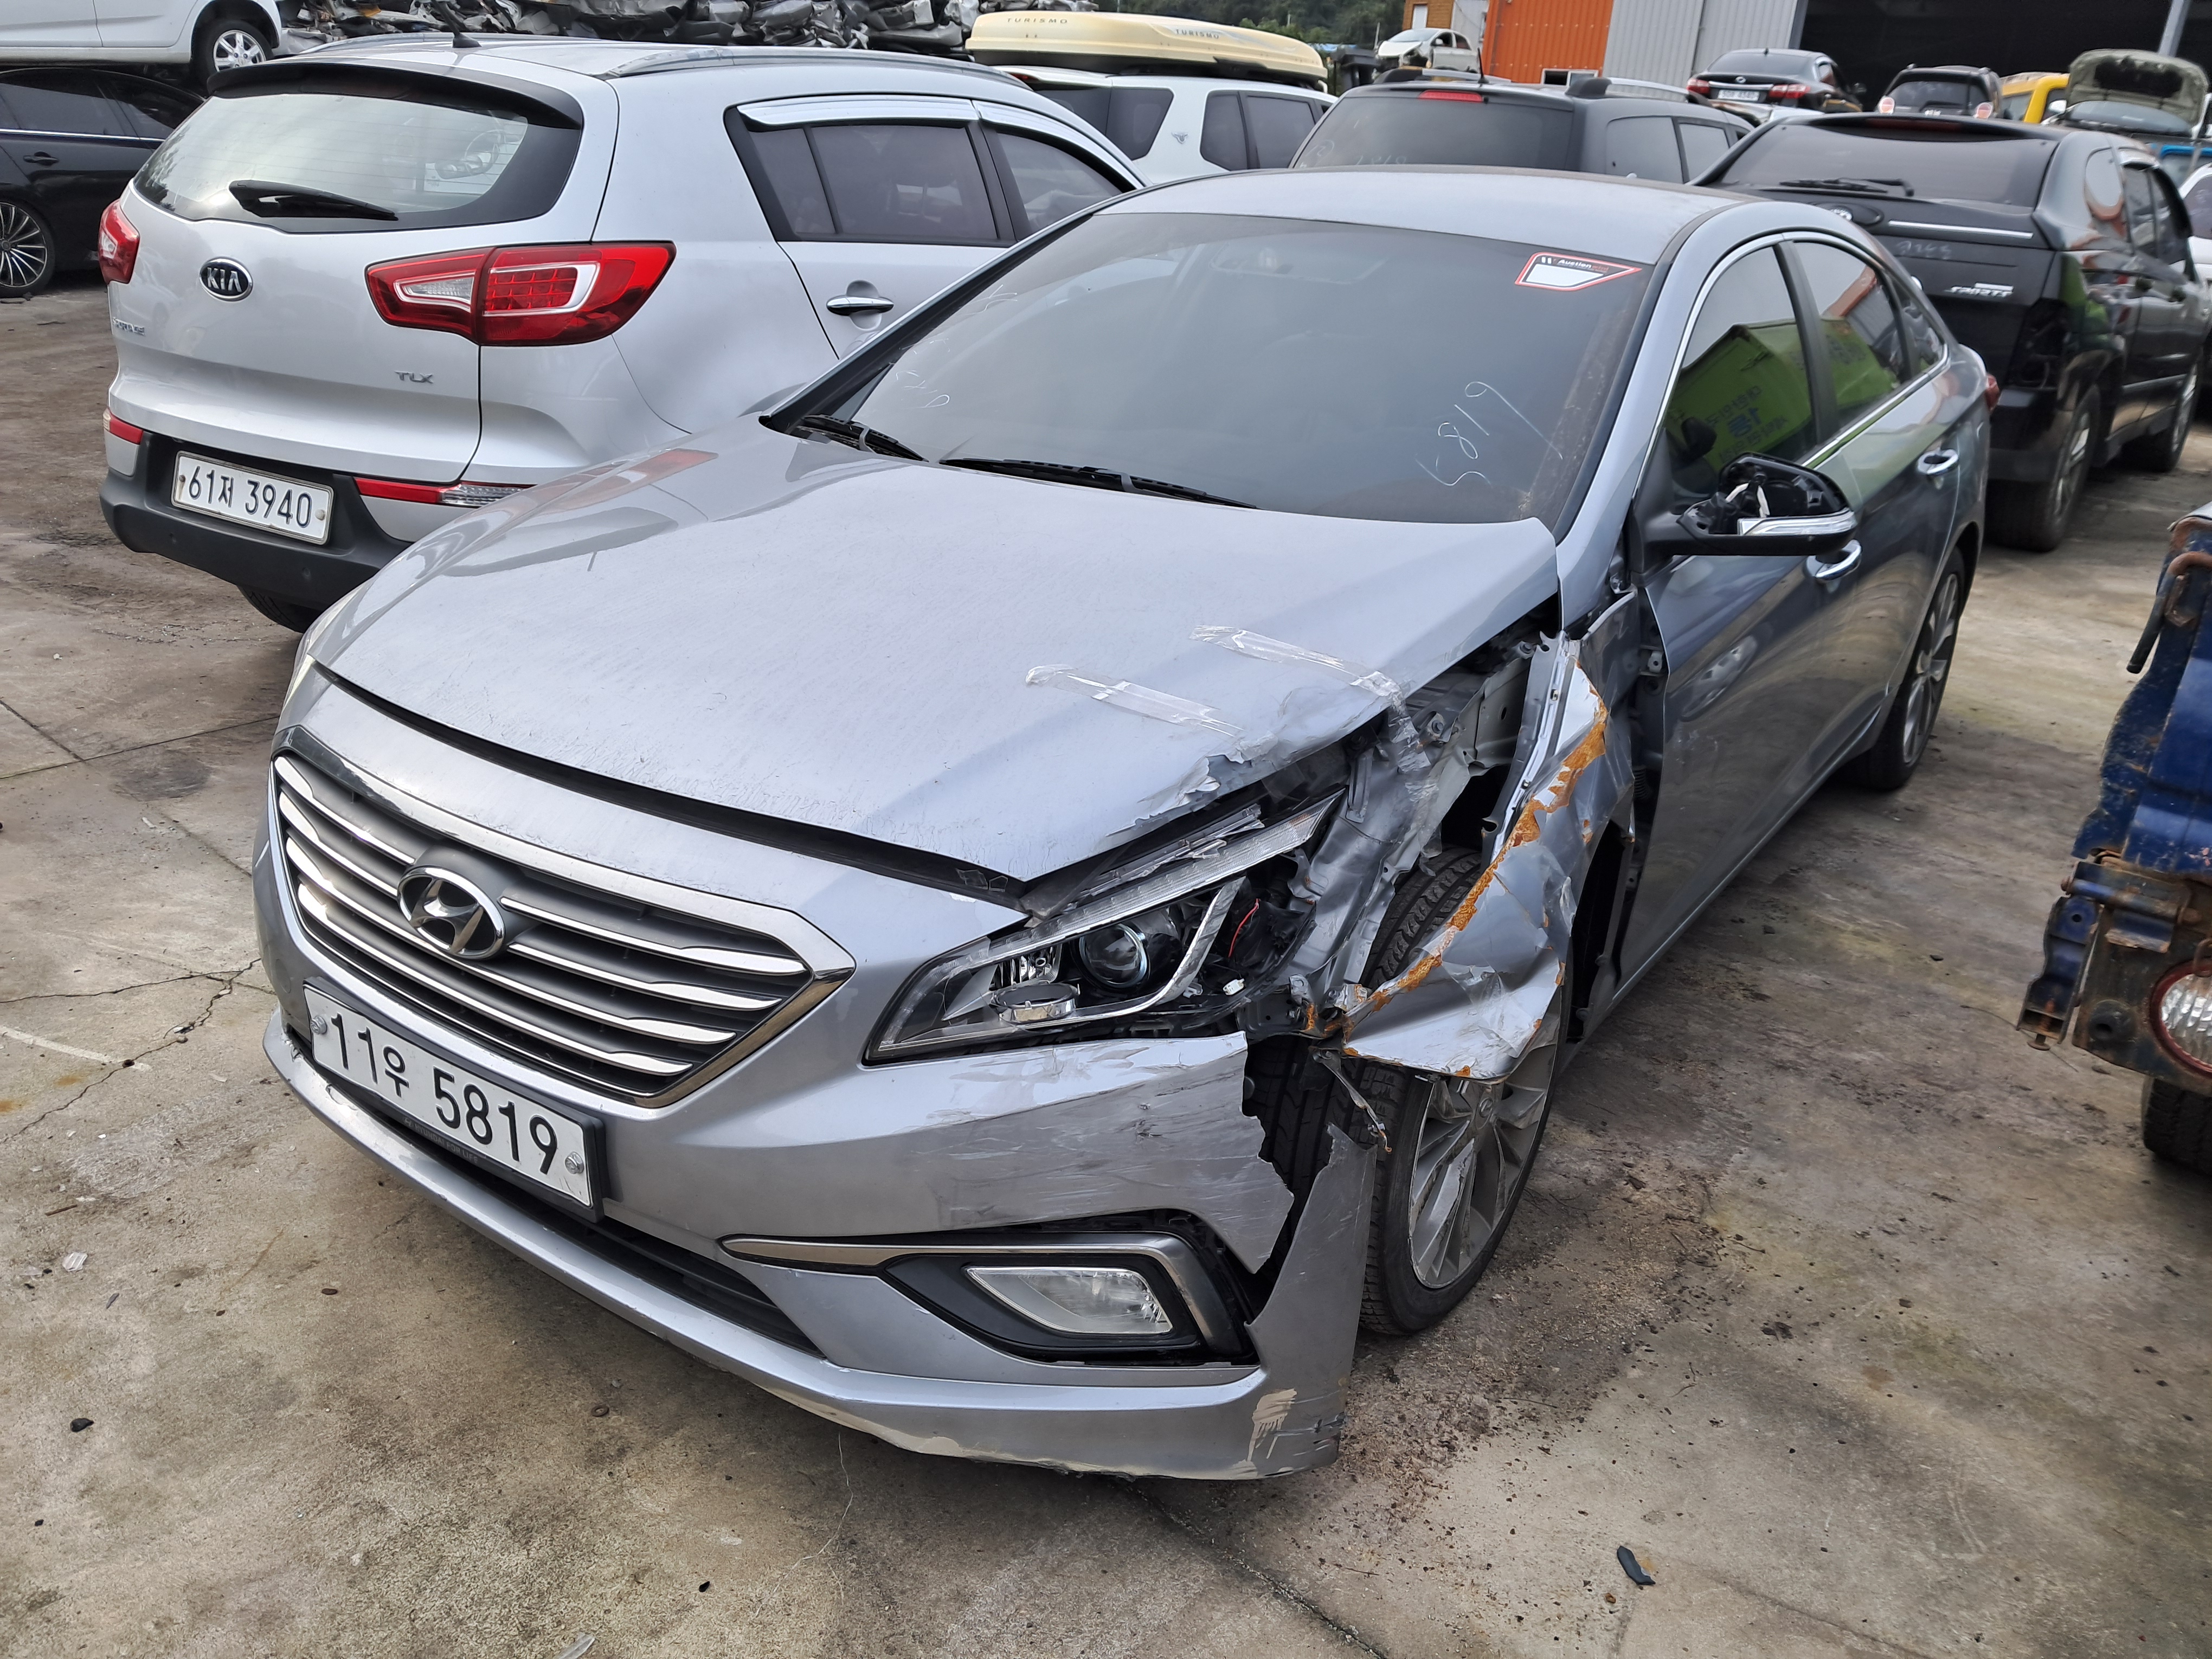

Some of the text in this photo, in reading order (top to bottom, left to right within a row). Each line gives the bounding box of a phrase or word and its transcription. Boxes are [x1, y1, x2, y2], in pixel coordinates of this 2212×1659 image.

[1175, 28, 1220, 40] TURISMO
[207, 267, 243, 293] KIA
[394, 370, 434, 384] TLX
[189, 465, 312, 528] 61저 3940
[330, 1012, 558, 1175] 11우 5819
[414, 1123, 479, 1165] HYUNDAI FOR LIFE
